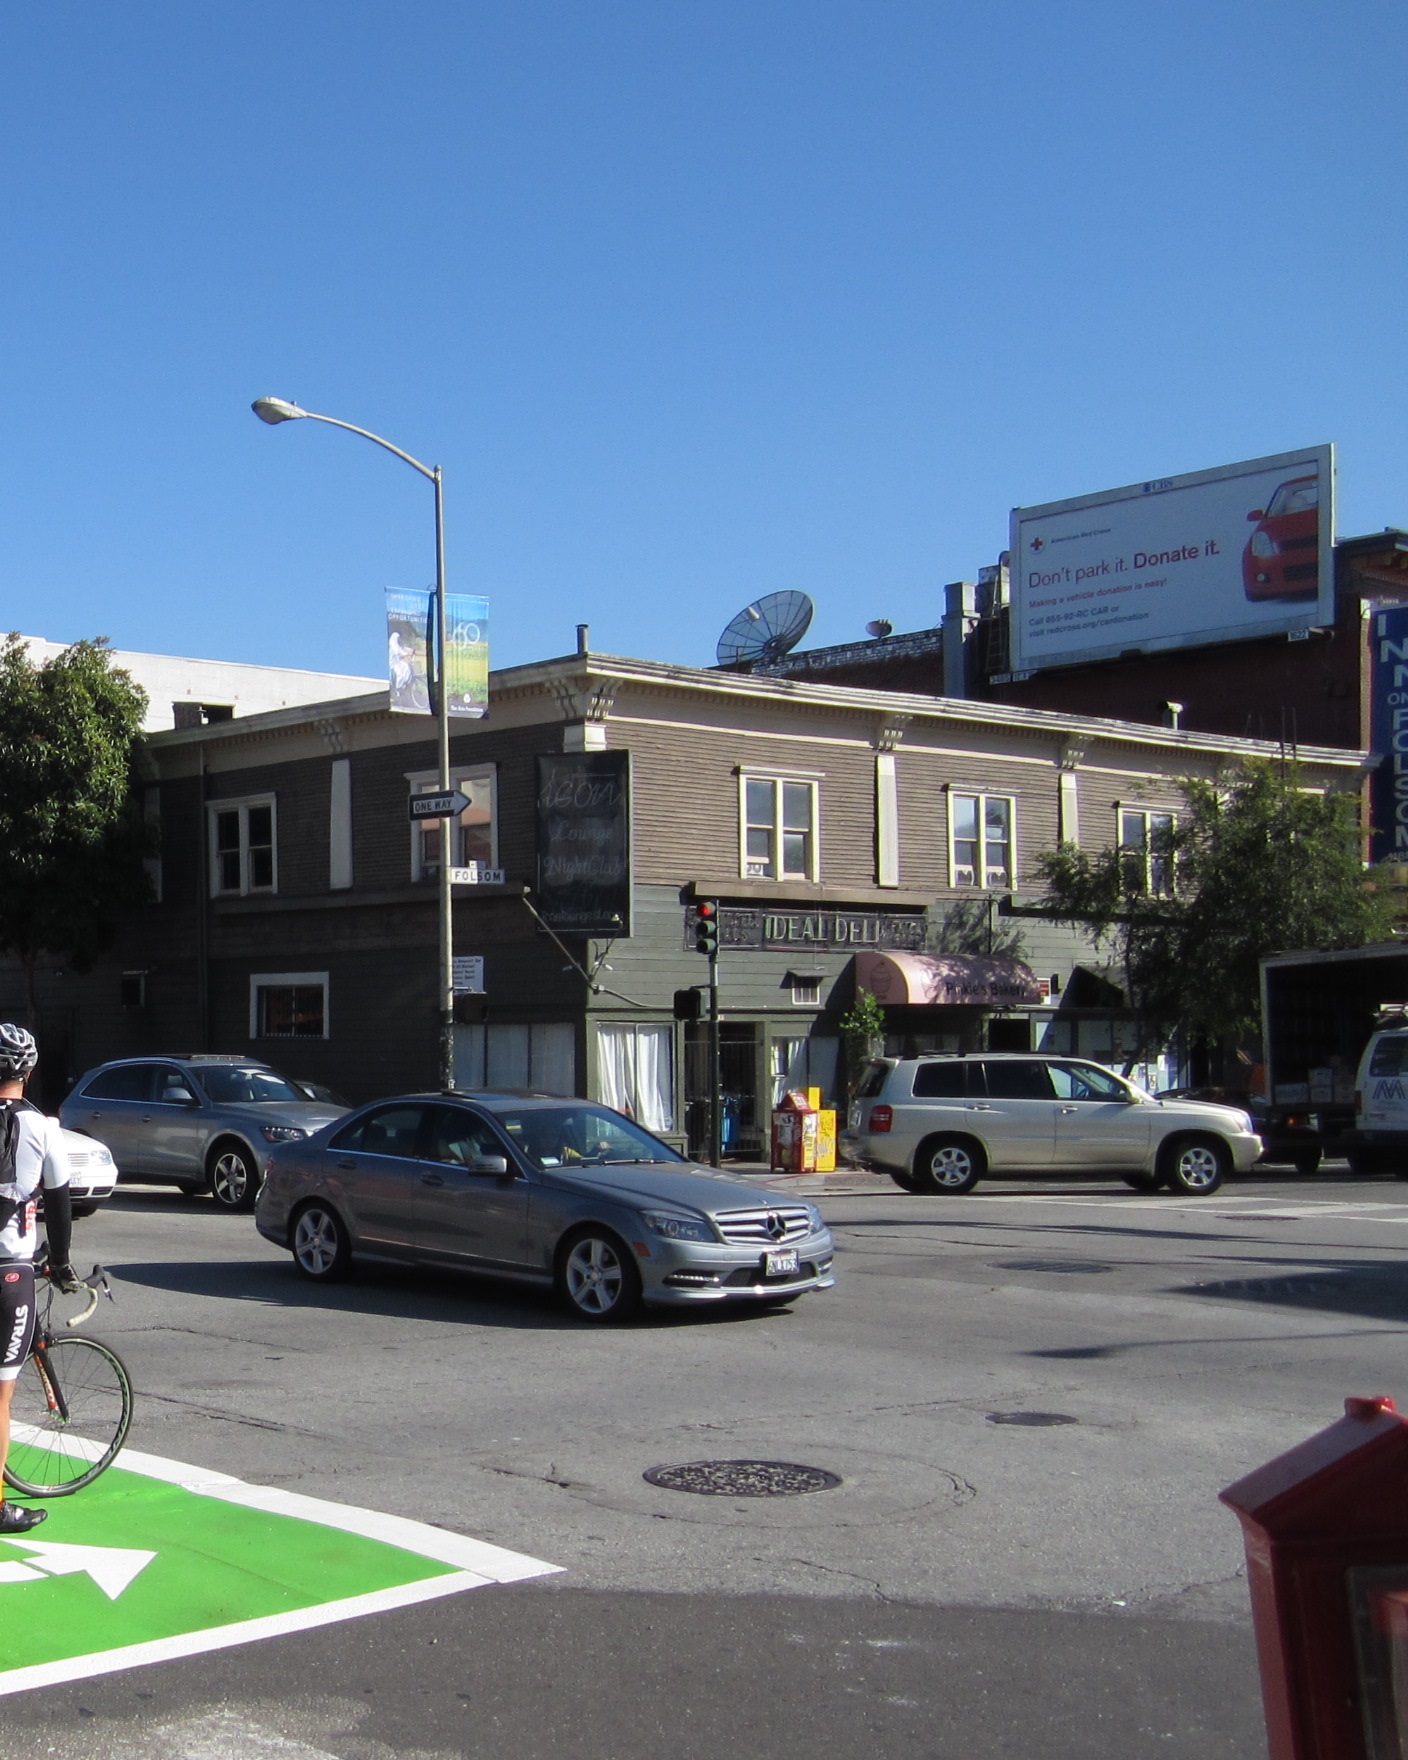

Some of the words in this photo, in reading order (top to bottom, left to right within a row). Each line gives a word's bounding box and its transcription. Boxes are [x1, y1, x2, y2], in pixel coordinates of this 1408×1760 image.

[1029, 567, 1071, 588] Don't
[1075, 560, 1111, 584] park
[1115, 557, 1128, 573] it.
[1134, 545, 1199, 570] Donate
[1205, 540, 1220, 557] it.
[1029, 598, 1057, 609] Making
[1066, 591, 1095, 602] vehicle
[1096, 584, 1132, 598] donation
[1134, 582, 1142, 590] is
[1144, 577, 1168, 589] easy!
[1029, 616, 1044, 626] Call
[1091, 606, 1109, 616] CAR
[1029, 628, 1045, 638] visit
[414, 801, 432, 812] ONE
[434, 799, 452, 810] WAY
[550, 819, 613, 846] Lounge
[454, 870, 501, 882] FOLSOM
[764, 914, 828, 941] IDEAL
[835, 913, 880, 943] DELI
[946, 982, 987, 997] Pinkie's
[990, 982, 1026, 998] Bakery
[3, 1303, 29, 1364] STRAVA
